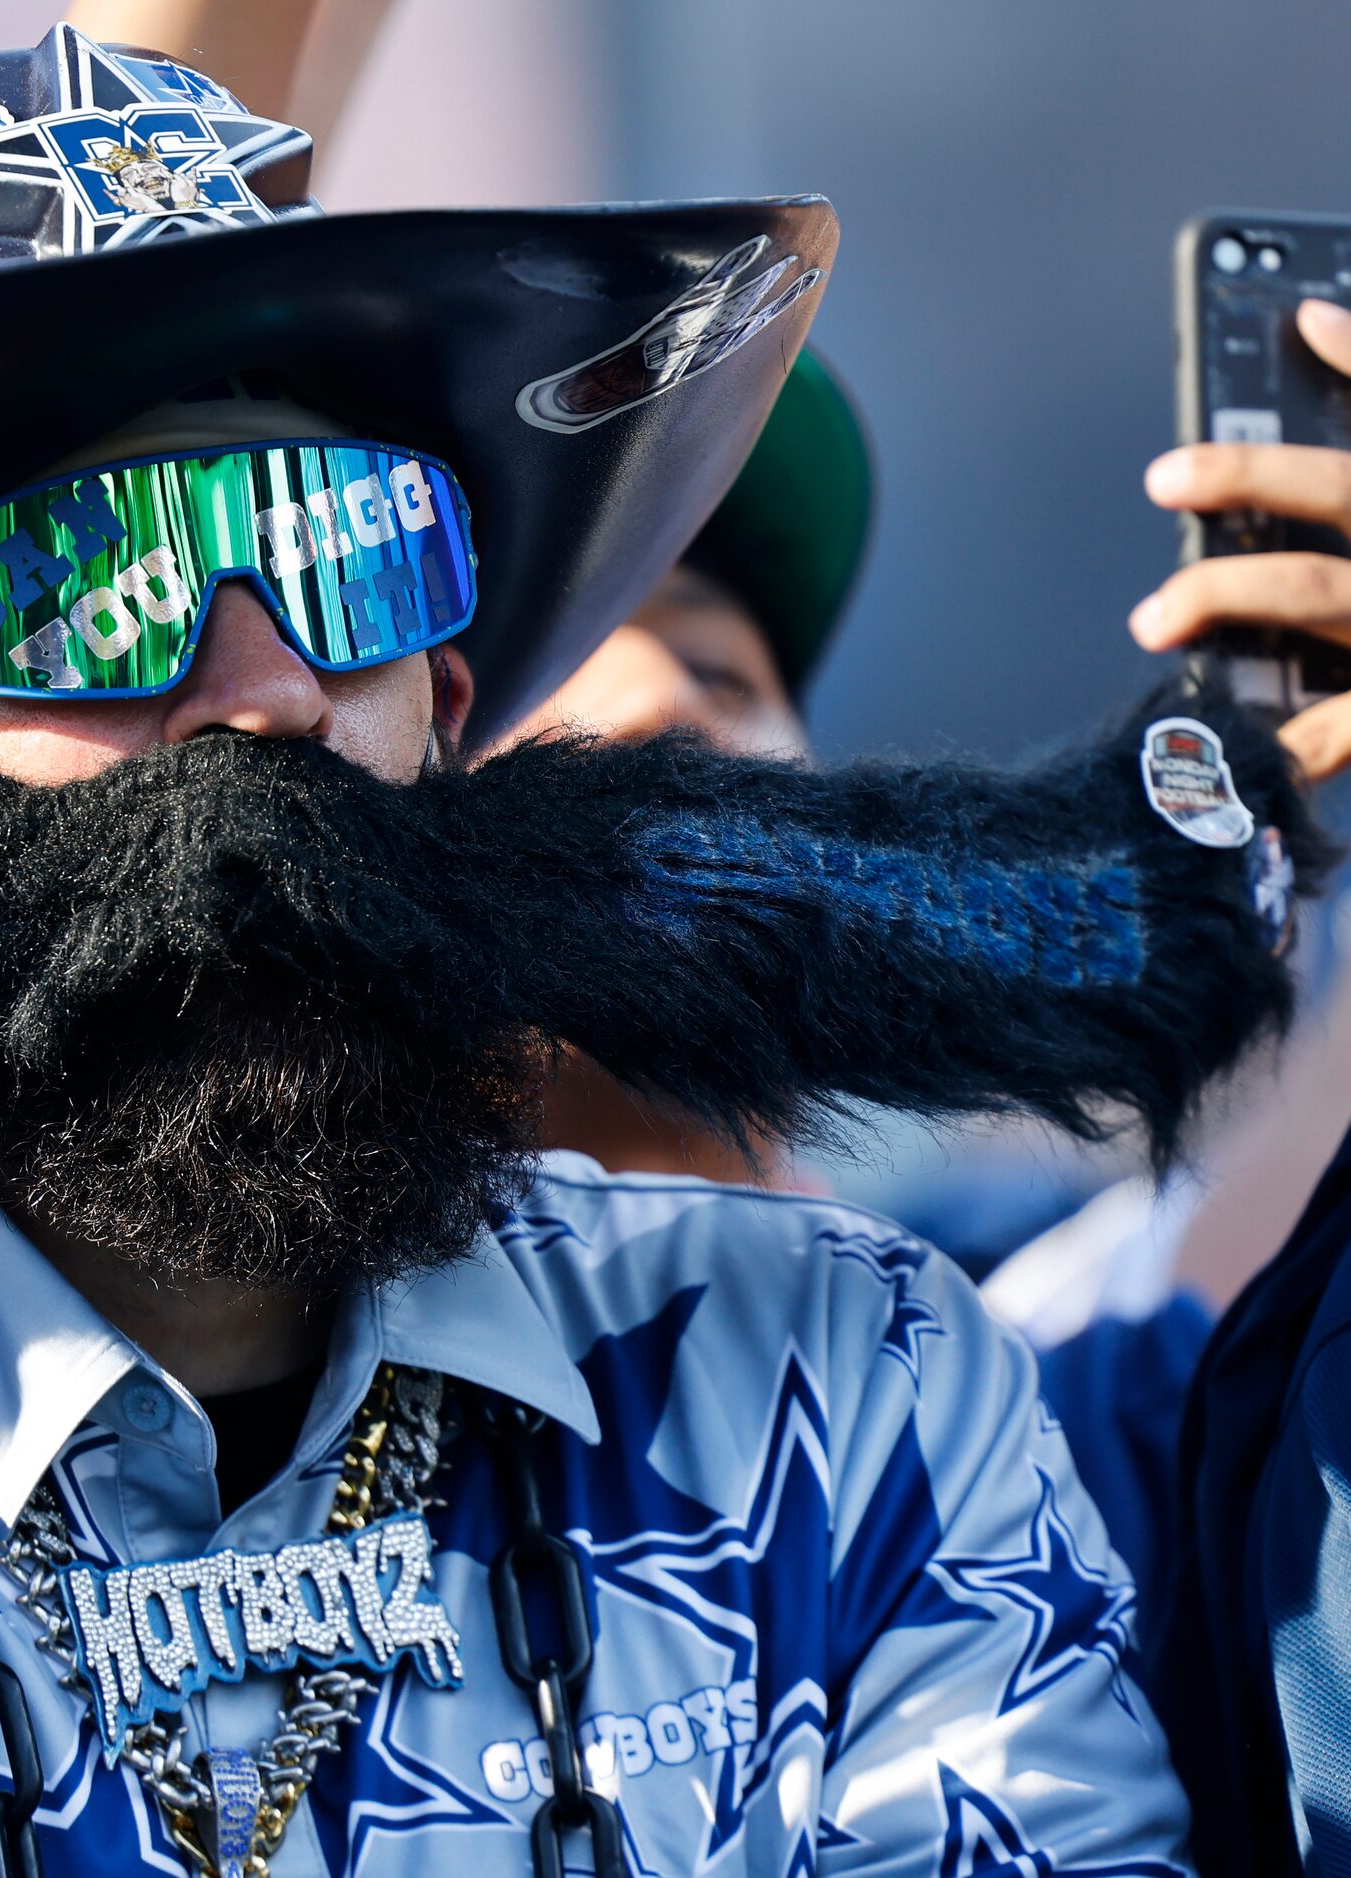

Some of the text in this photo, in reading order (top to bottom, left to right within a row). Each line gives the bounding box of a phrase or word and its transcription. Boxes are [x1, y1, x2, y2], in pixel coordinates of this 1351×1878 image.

[254, 460, 437, 579] DIGG
[8, 544, 191, 688] YOU
[68, 1519, 464, 1743] HOTBOYZ
